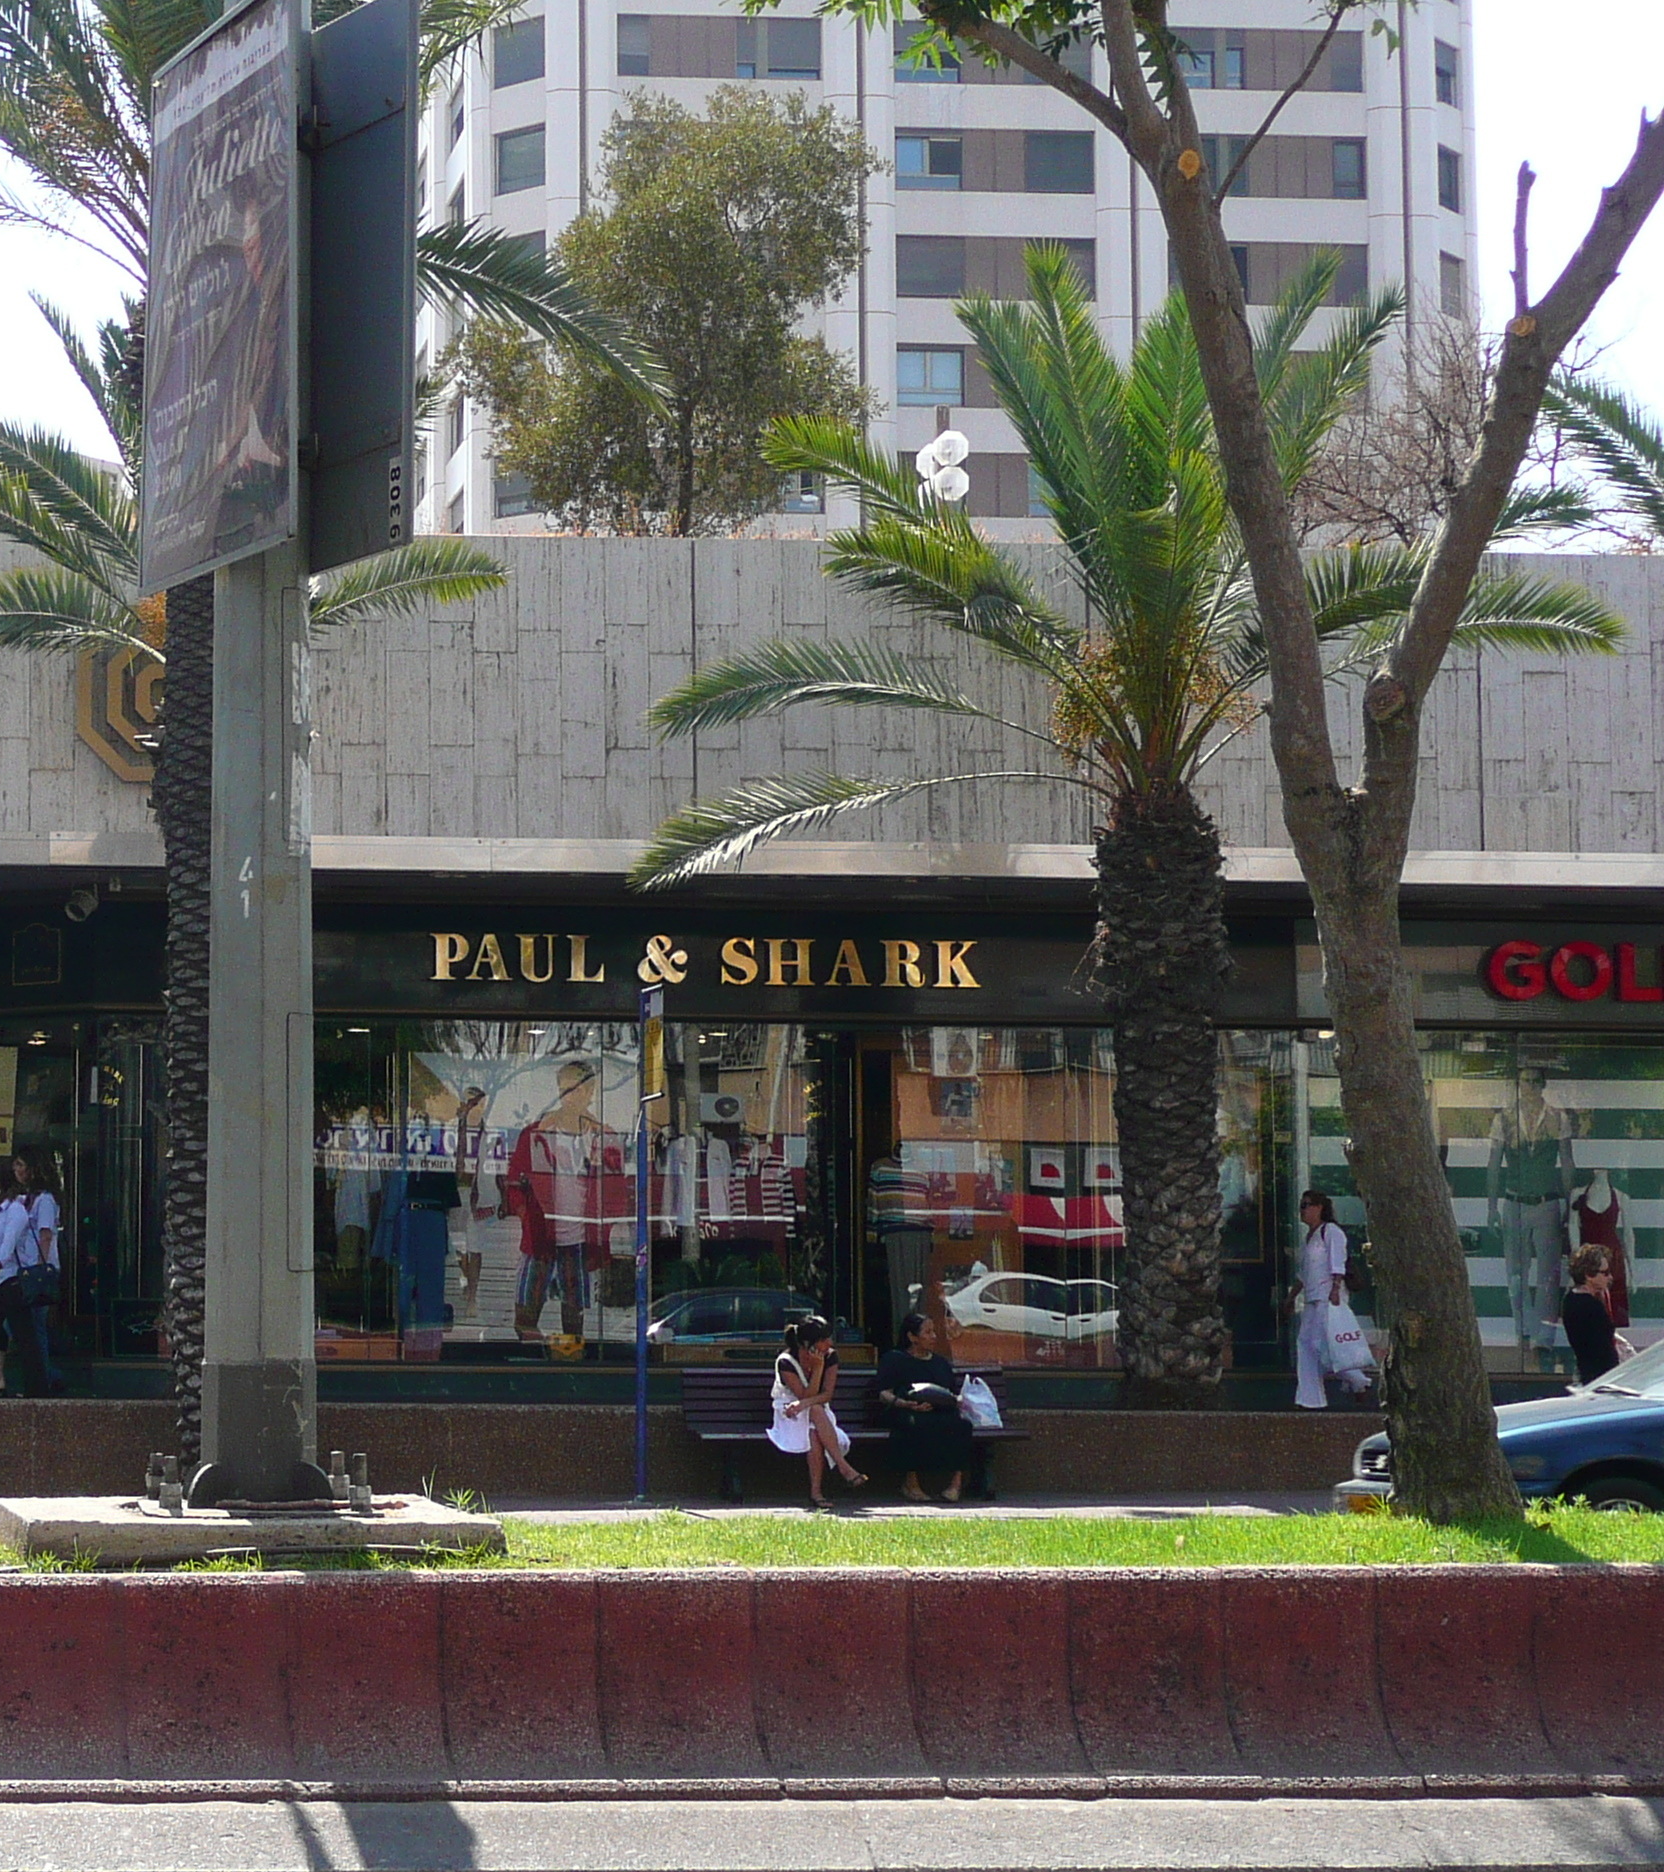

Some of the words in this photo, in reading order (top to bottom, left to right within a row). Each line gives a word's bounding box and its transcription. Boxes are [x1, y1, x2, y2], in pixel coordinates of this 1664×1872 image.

[390, 466, 401, 539] 9308
[429, 933, 605, 983] PAUL
[637, 934, 688, 983] &
[720, 936, 982, 988] SHARK
[1490, 939, 1664, 1002] GOL
[1335, 1330, 1361, 1344] GOLF
